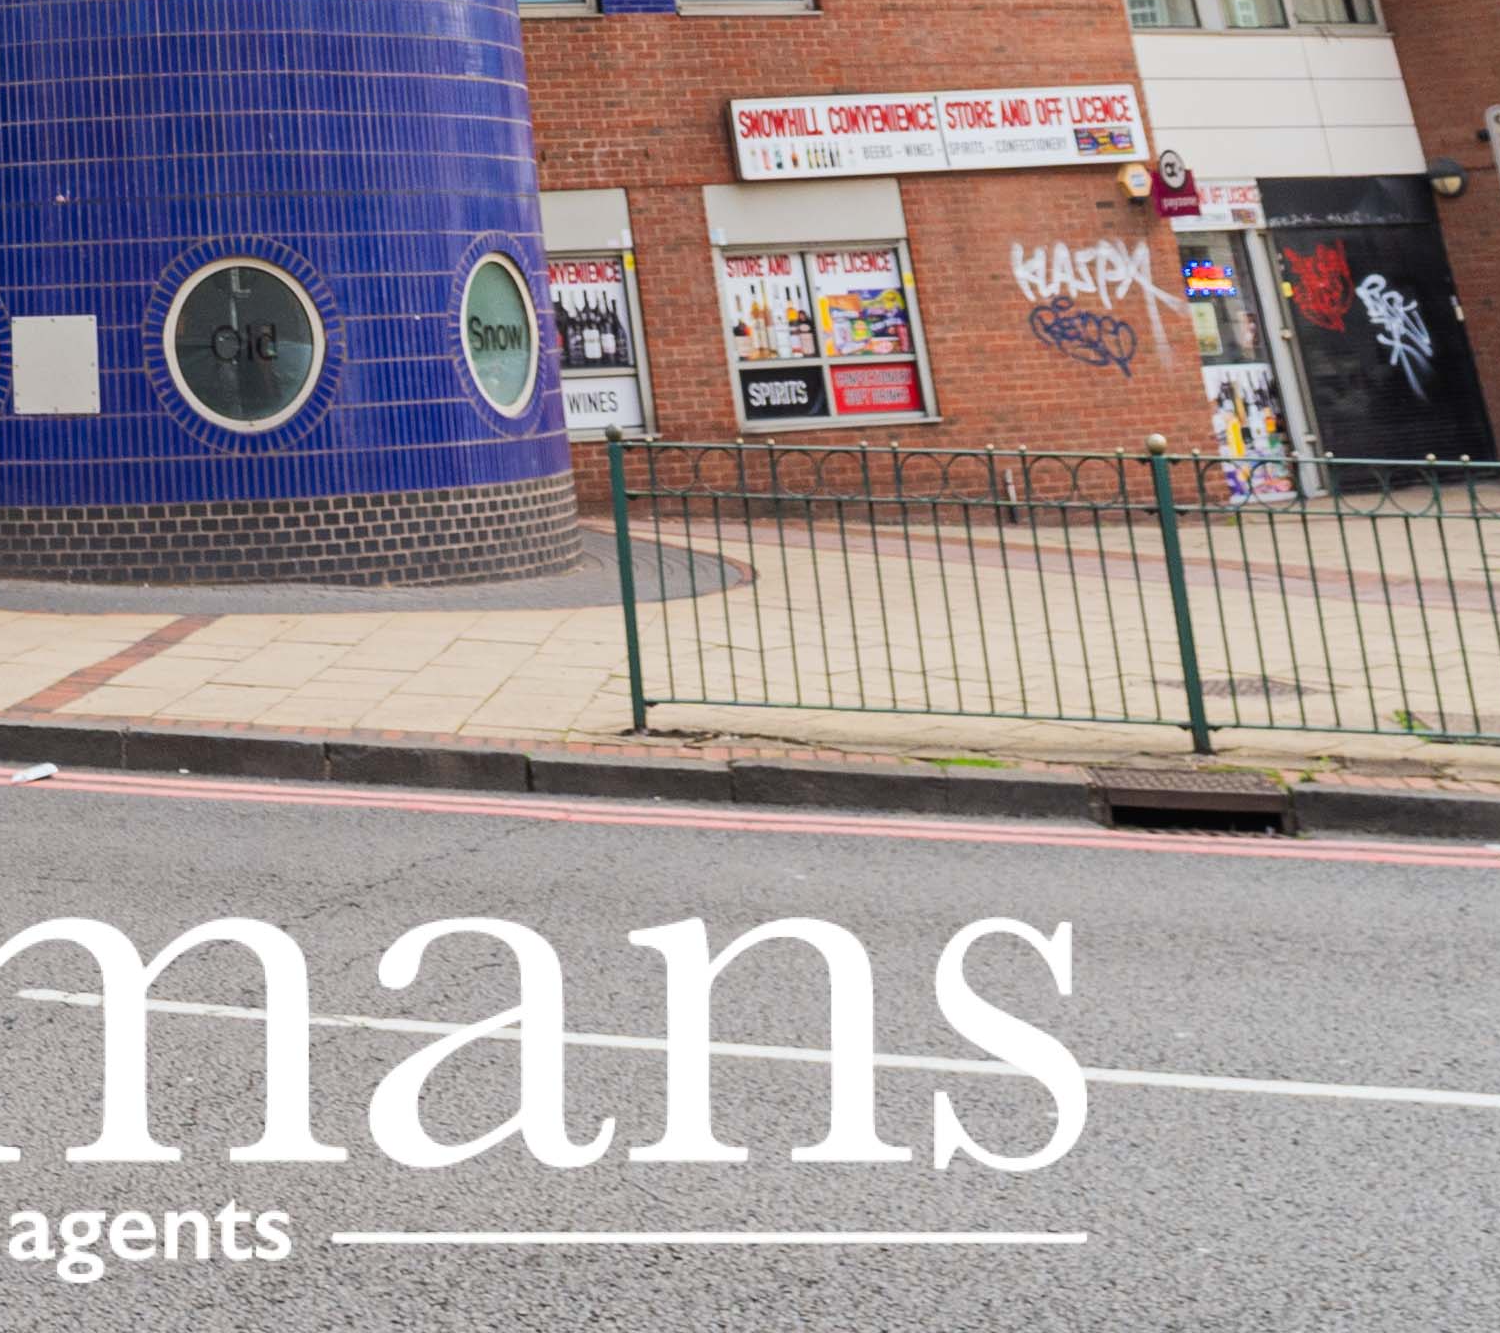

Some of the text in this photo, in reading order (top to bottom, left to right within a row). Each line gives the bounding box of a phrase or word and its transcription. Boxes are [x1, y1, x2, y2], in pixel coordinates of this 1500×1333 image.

[738, 95, 1134, 140] SNOWHILL CONVENIENCE STORE AND OFF LICENCE
[549, 261, 622, 284] NVENIENCE
[725, 253, 793, 278] STORE AND
[814, 249, 893, 275] OFF LICENCE
[211, 324, 278, 362] Old
[468, 315, 523, 352] Snow
[566, 390, 619, 415] WINES
[748, 380, 809, 407] SPIRITS
